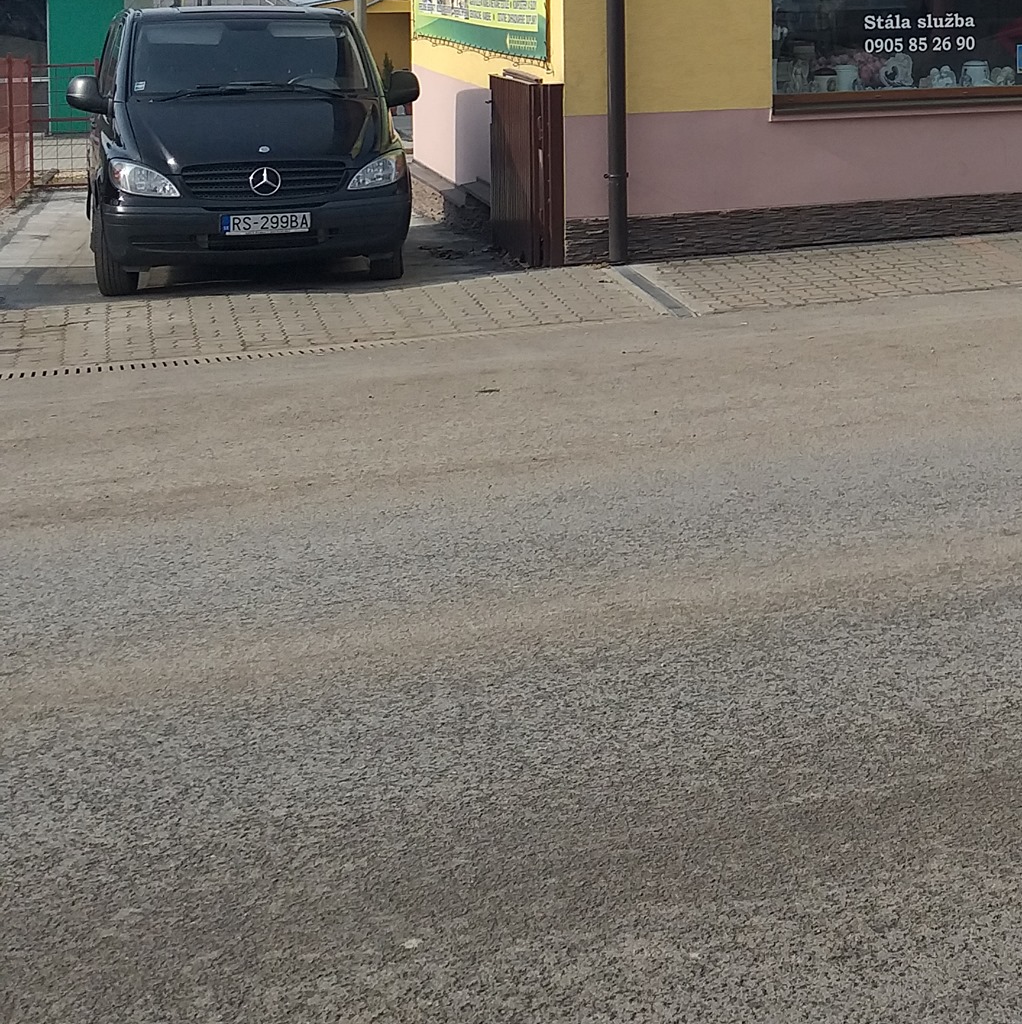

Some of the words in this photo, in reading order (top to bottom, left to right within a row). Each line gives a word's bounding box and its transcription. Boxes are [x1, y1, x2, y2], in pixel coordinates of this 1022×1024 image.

[864, 13, 911, 30] Stála
[917, 13, 975, 29] služba
[864, 37, 904, 53] 0905
[908, 37, 928, 52] 85
[932, 36, 952, 51] 26
[955, 36, 976, 51] 90
[232, 214, 309, 231] RS-299BA
